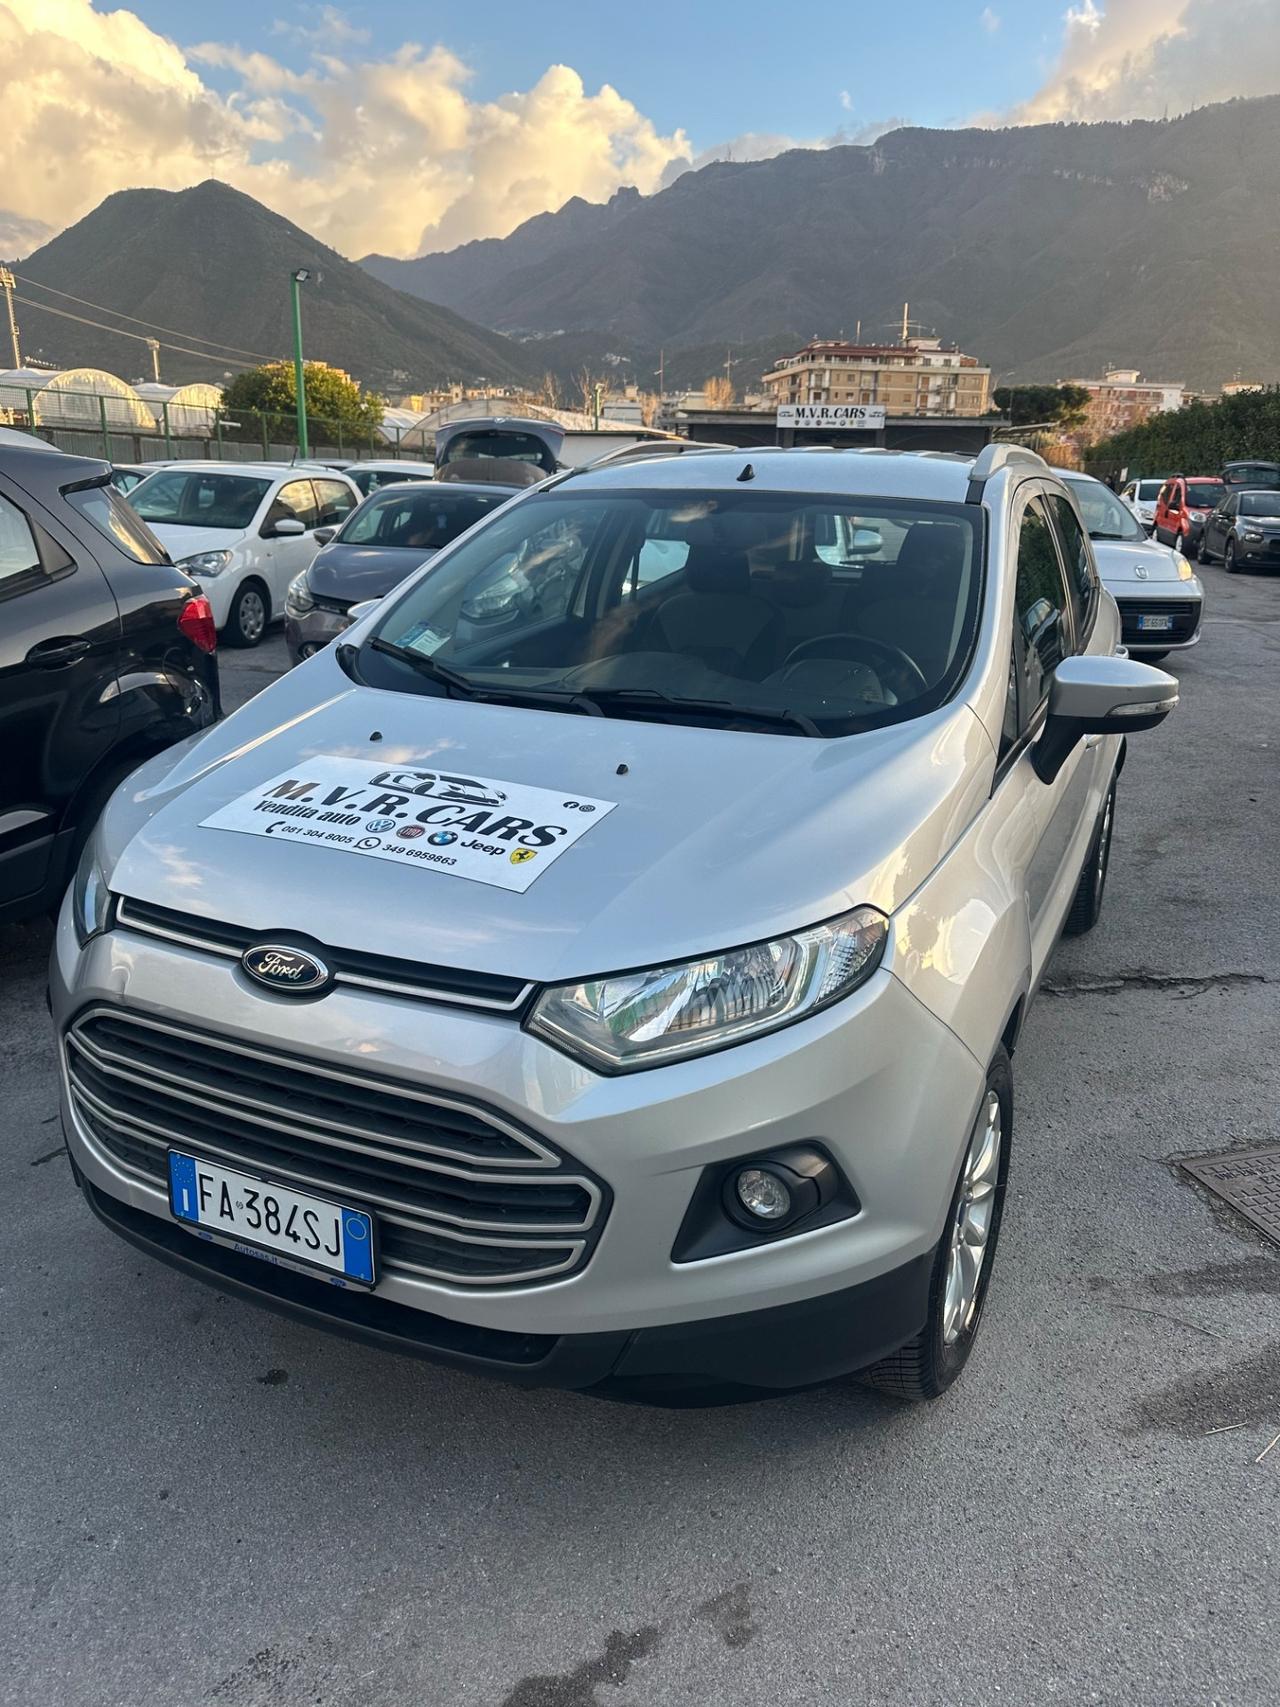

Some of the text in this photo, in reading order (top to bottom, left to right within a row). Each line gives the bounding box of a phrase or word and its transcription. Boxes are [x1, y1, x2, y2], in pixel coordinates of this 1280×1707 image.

[253, 800, 362, 826] Vendita auto
[281, 825, 356, 844] 081 304 8005
[382, 844, 458, 866] 349 6959863
[460, 839, 506, 856] Jeep
[258, 951, 305, 980] Ford
